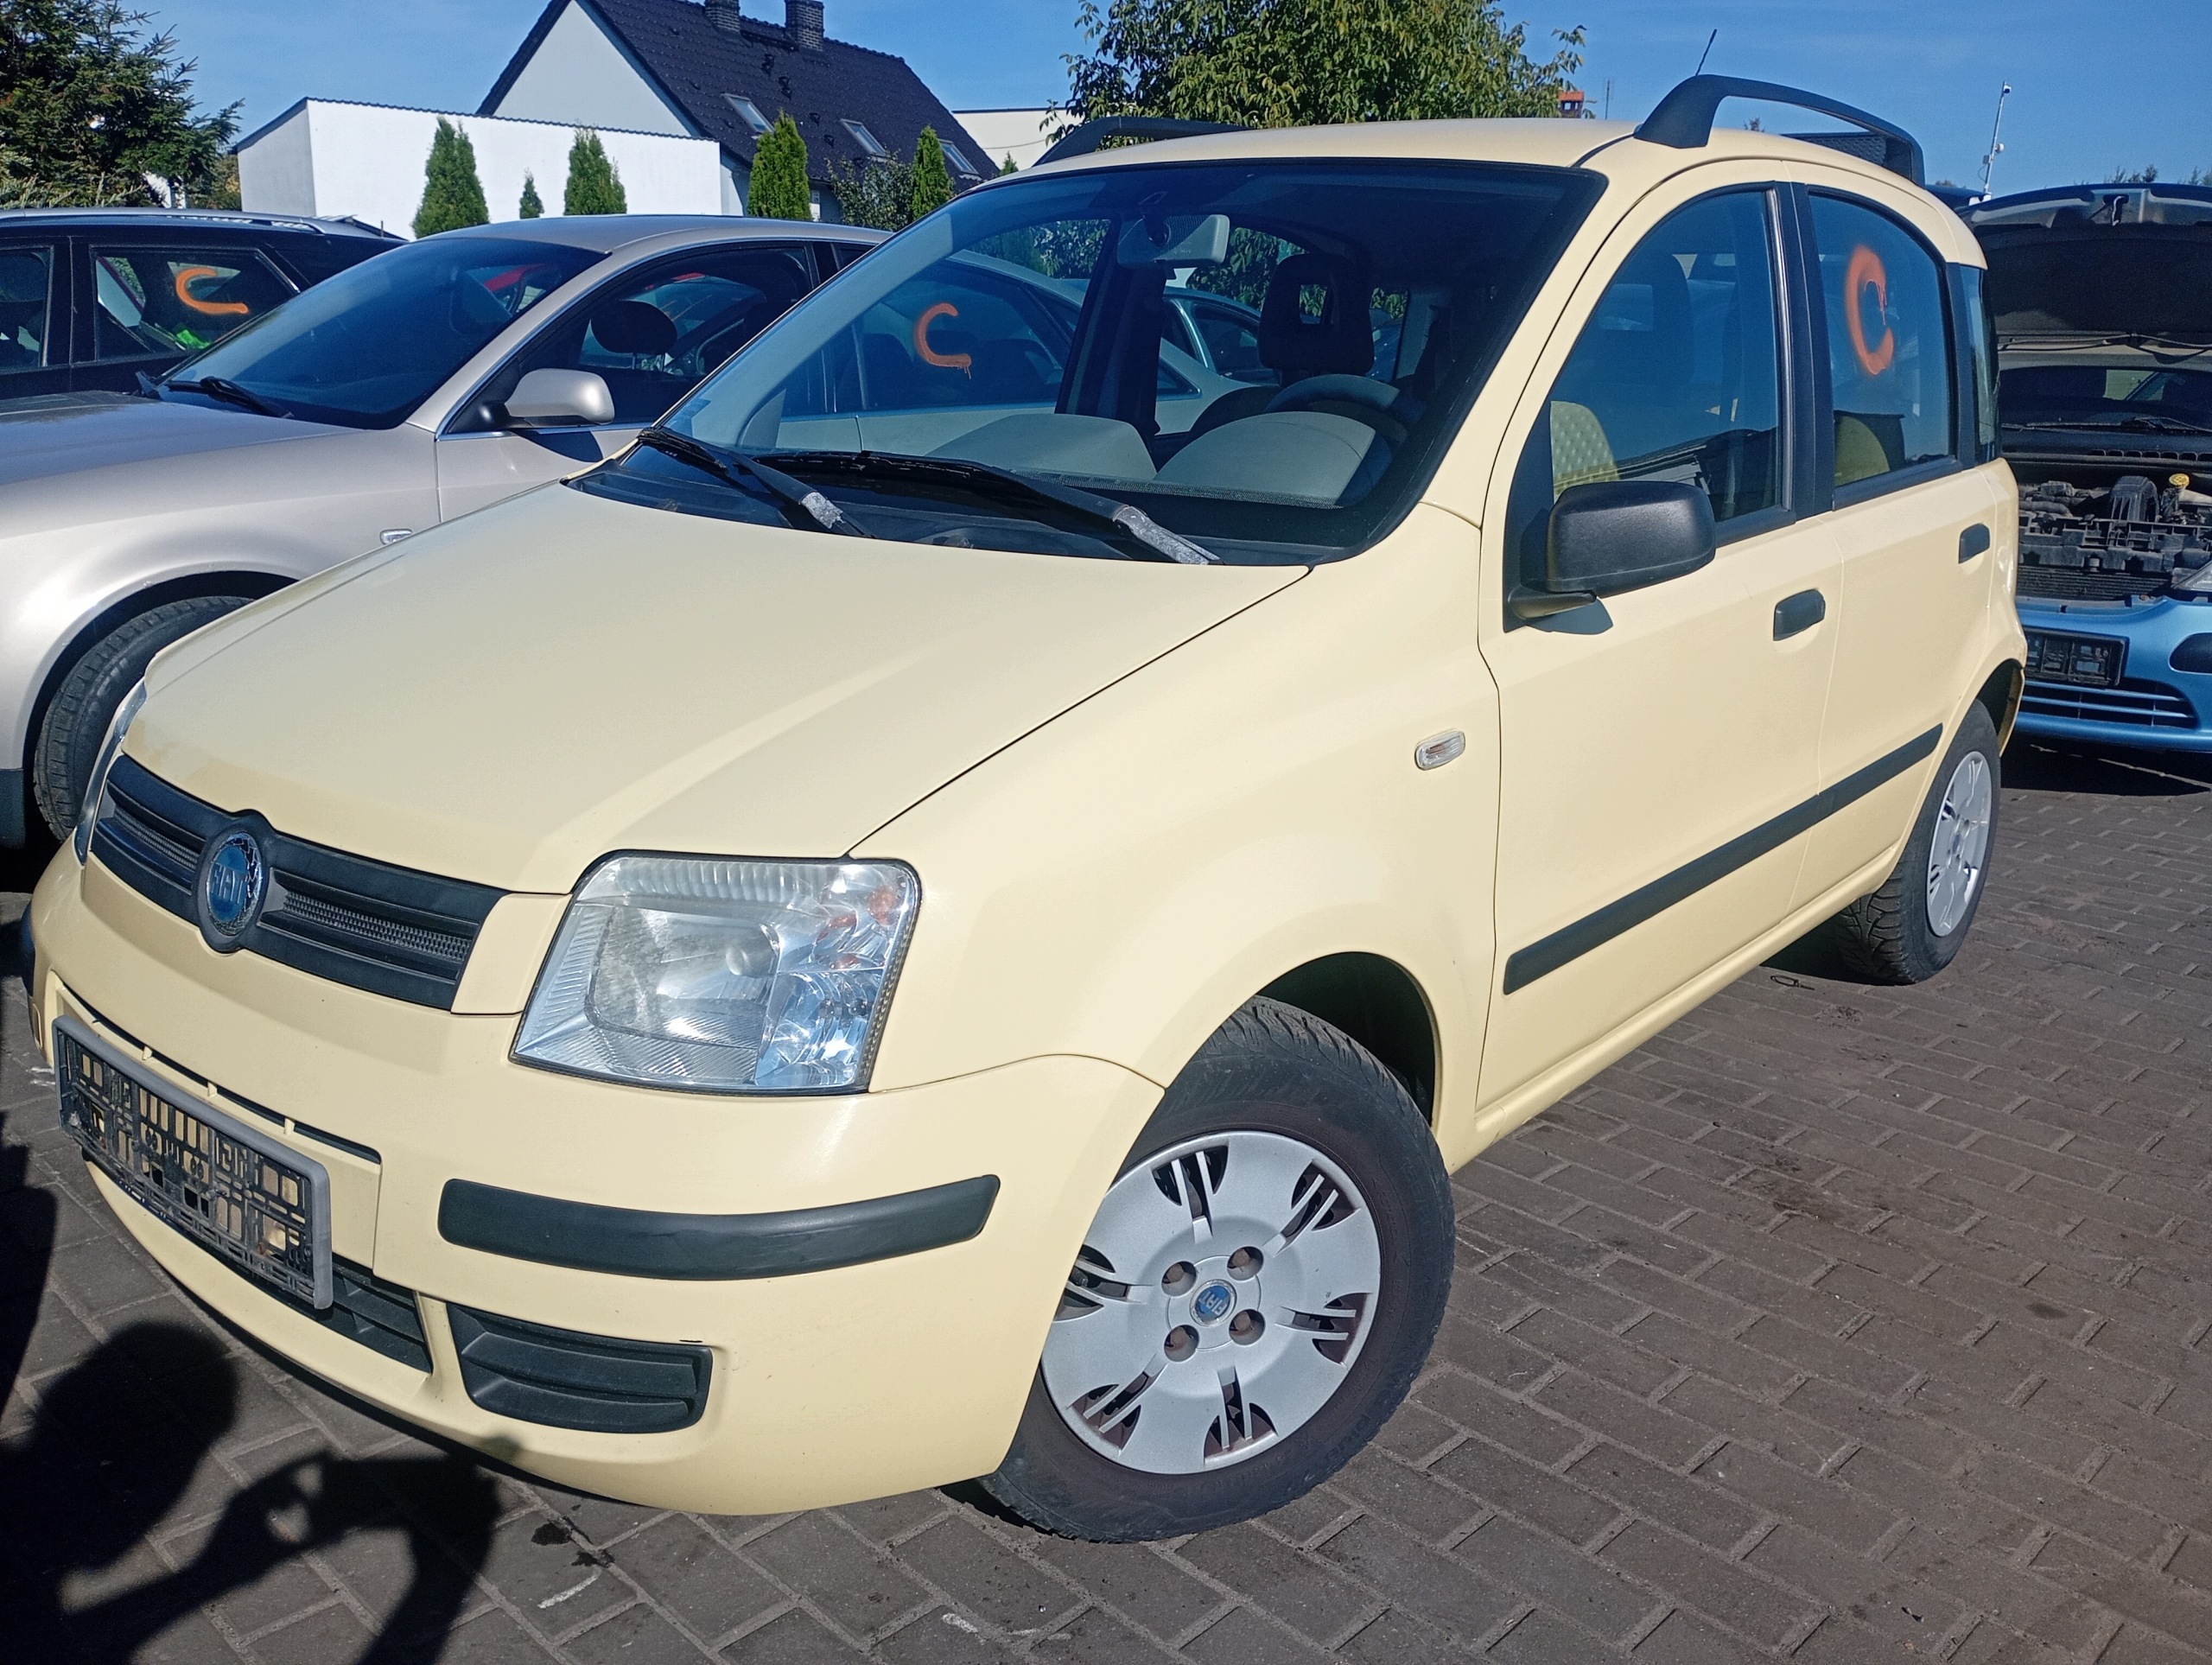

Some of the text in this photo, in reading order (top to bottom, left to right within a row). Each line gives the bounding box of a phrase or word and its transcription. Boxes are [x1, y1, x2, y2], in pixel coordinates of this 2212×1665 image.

[175, 267, 249, 315] C
[1845, 244, 1894, 375] C
[915, 303, 972, 372] C
[1198, 1290, 1228, 1316] FIAT
